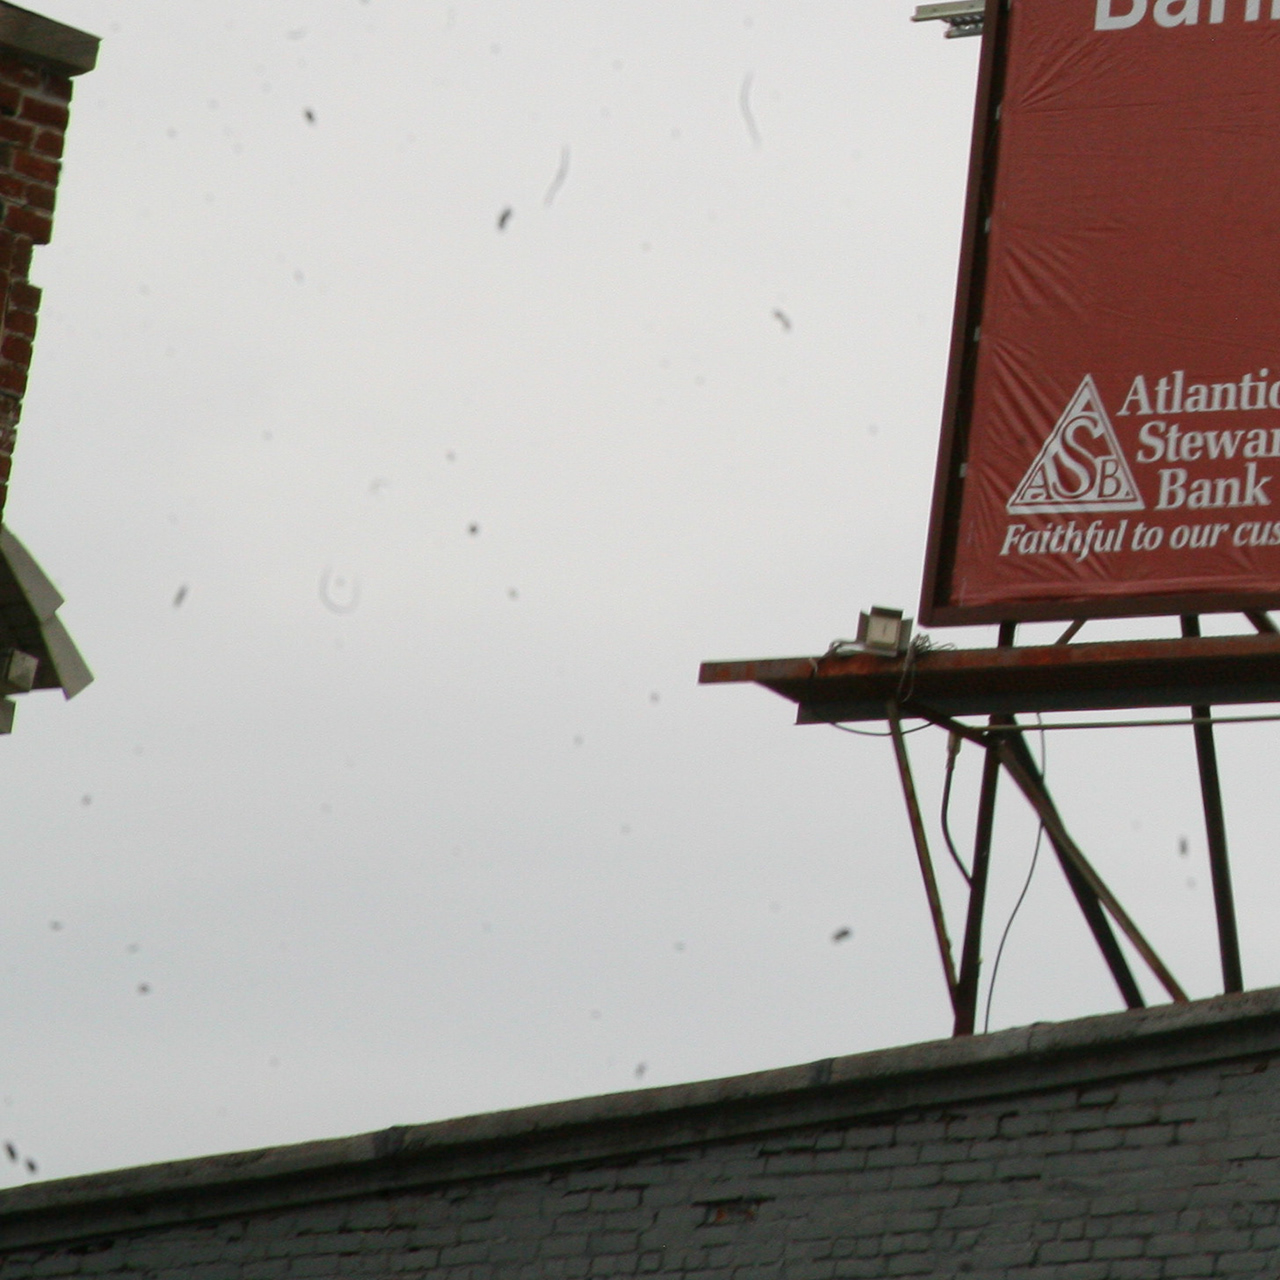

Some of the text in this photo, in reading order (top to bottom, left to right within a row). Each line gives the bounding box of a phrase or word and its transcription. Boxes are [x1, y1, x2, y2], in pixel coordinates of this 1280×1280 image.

[1154, 464, 1272, 510] Bank
[1000, 518, 1128, 562] Faithful
[1132, 522, 1164, 551] to
[1171, 524, 1229, 549] our
